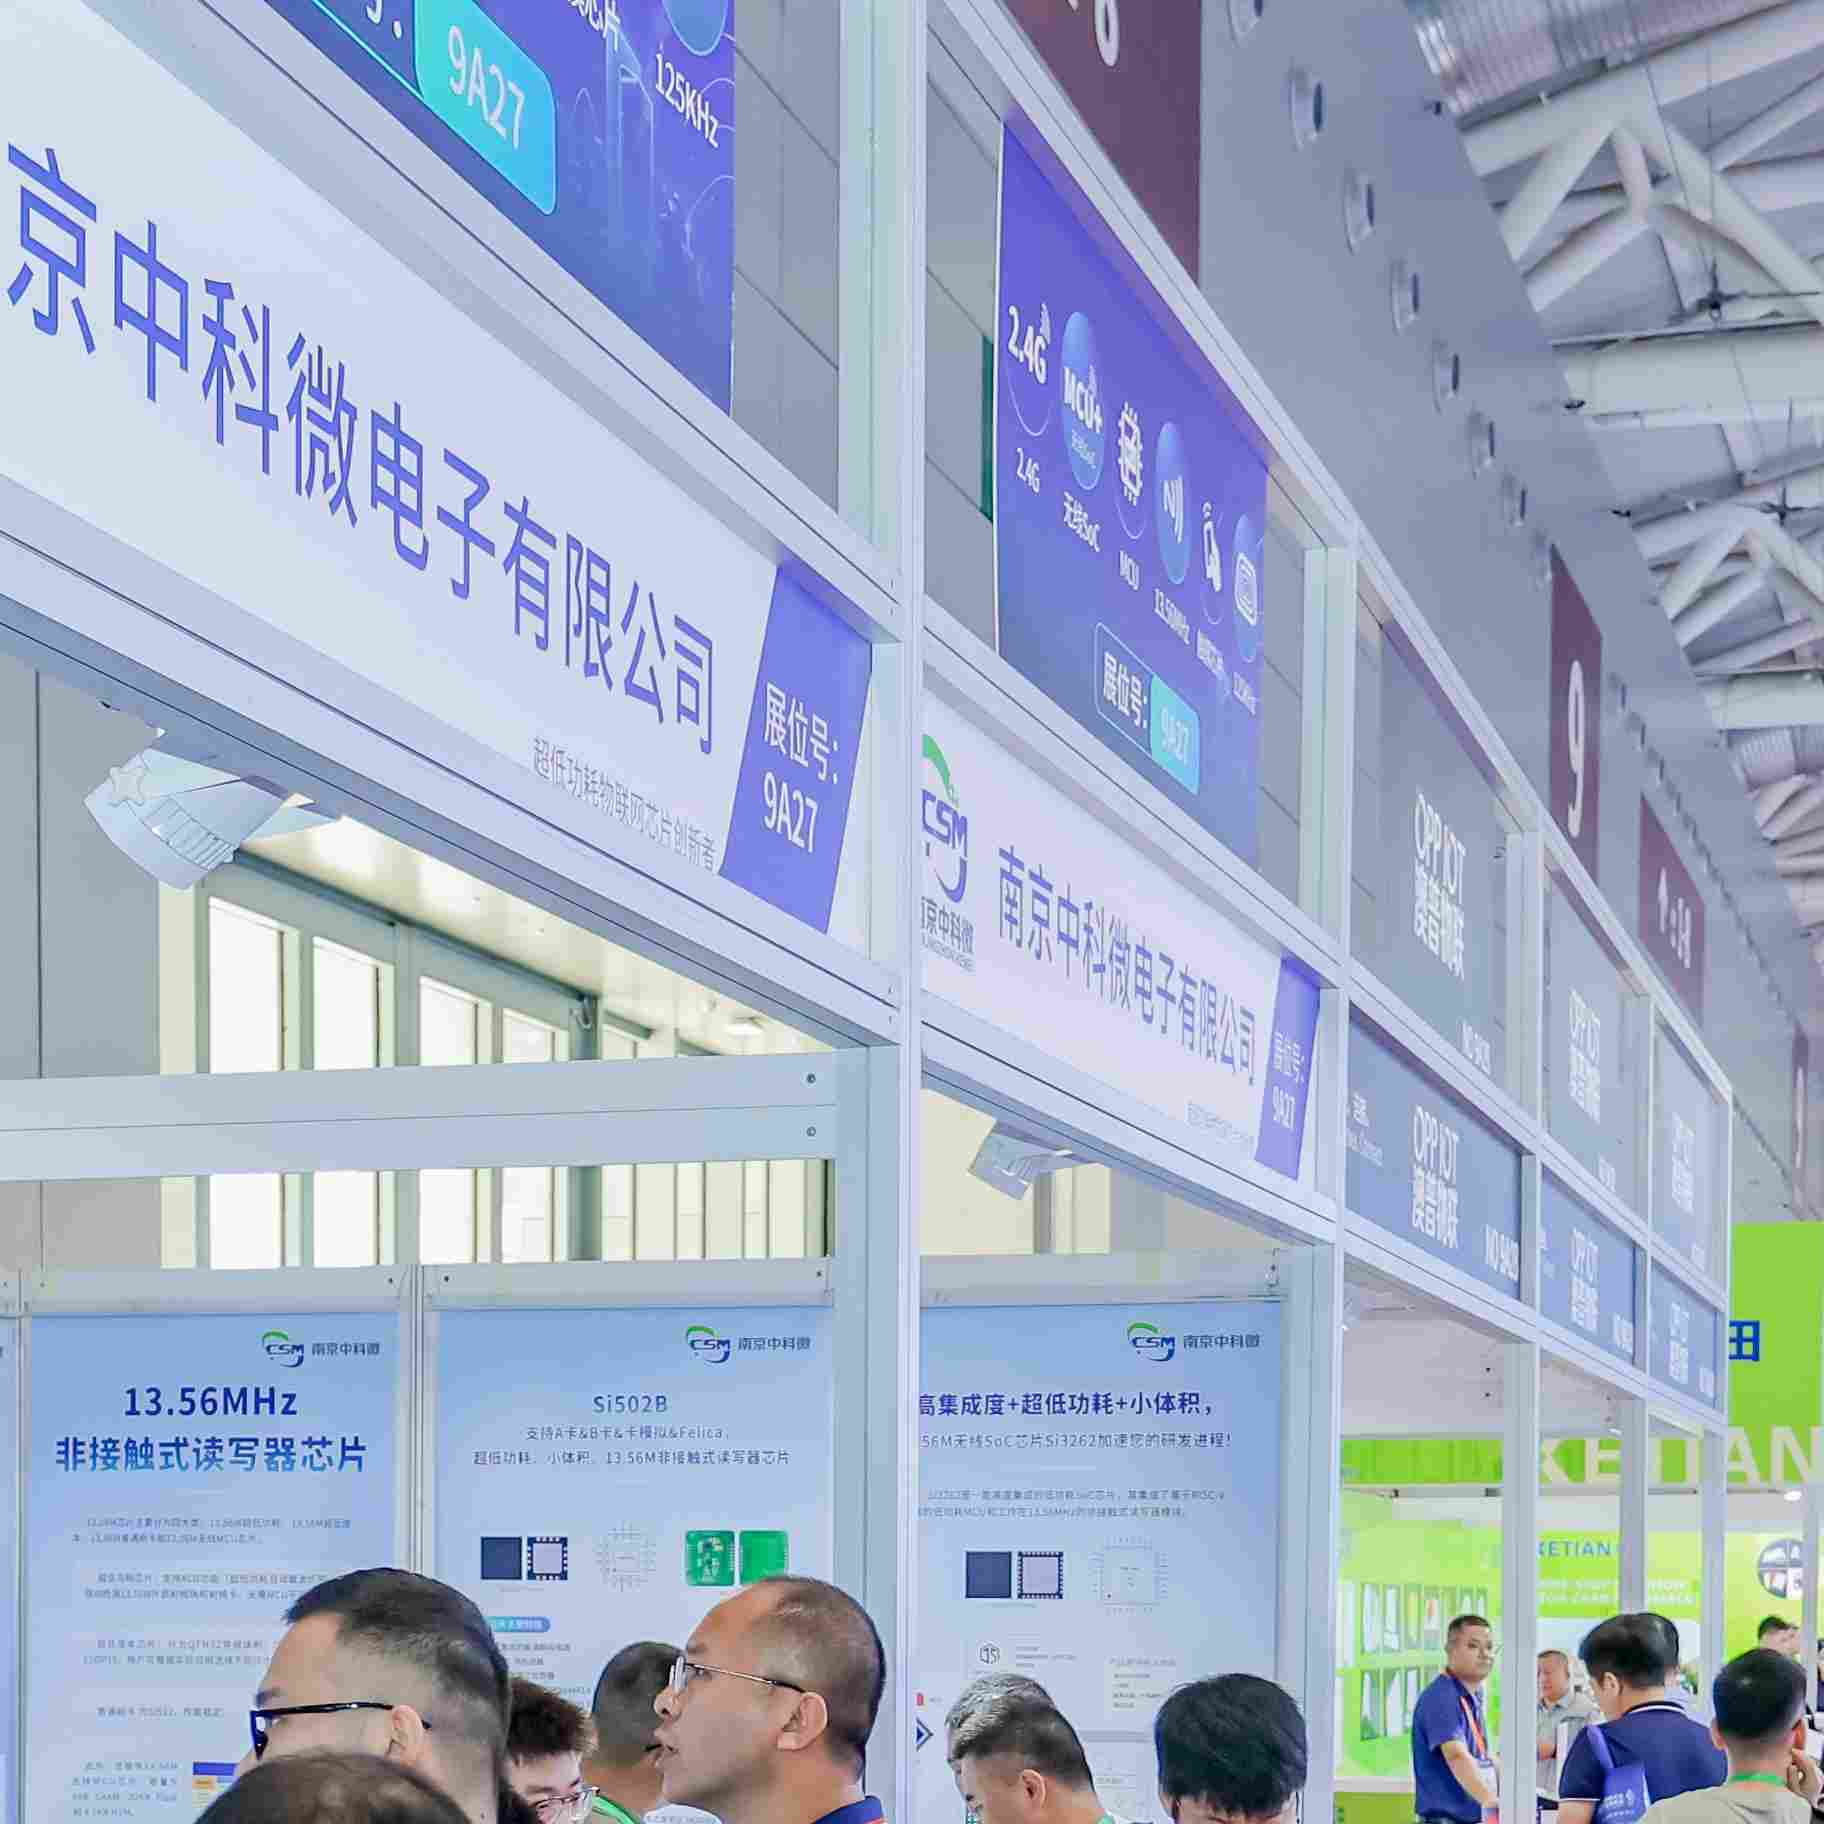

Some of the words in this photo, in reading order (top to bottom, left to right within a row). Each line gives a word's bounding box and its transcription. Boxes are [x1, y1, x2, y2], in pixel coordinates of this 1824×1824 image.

[447, 25, 525, 149] 9A27
[655, 52, 720, 149] 125KHz
[1008, 304, 1047, 384] 2.4G
[1016, 447, 1041, 493] 2.4G
[1567, 660, 1584, 838] 9
[763, 771, 819, 854] 9A27
[998, 845, 1257, 1086] 南京中科微电子有限公司
[124, 1386, 298, 1417] 13.56MHz
[592, 1394, 668, 1414] Si502B
[56, 1436, 367, 1473] 非接触式读写器芯片
